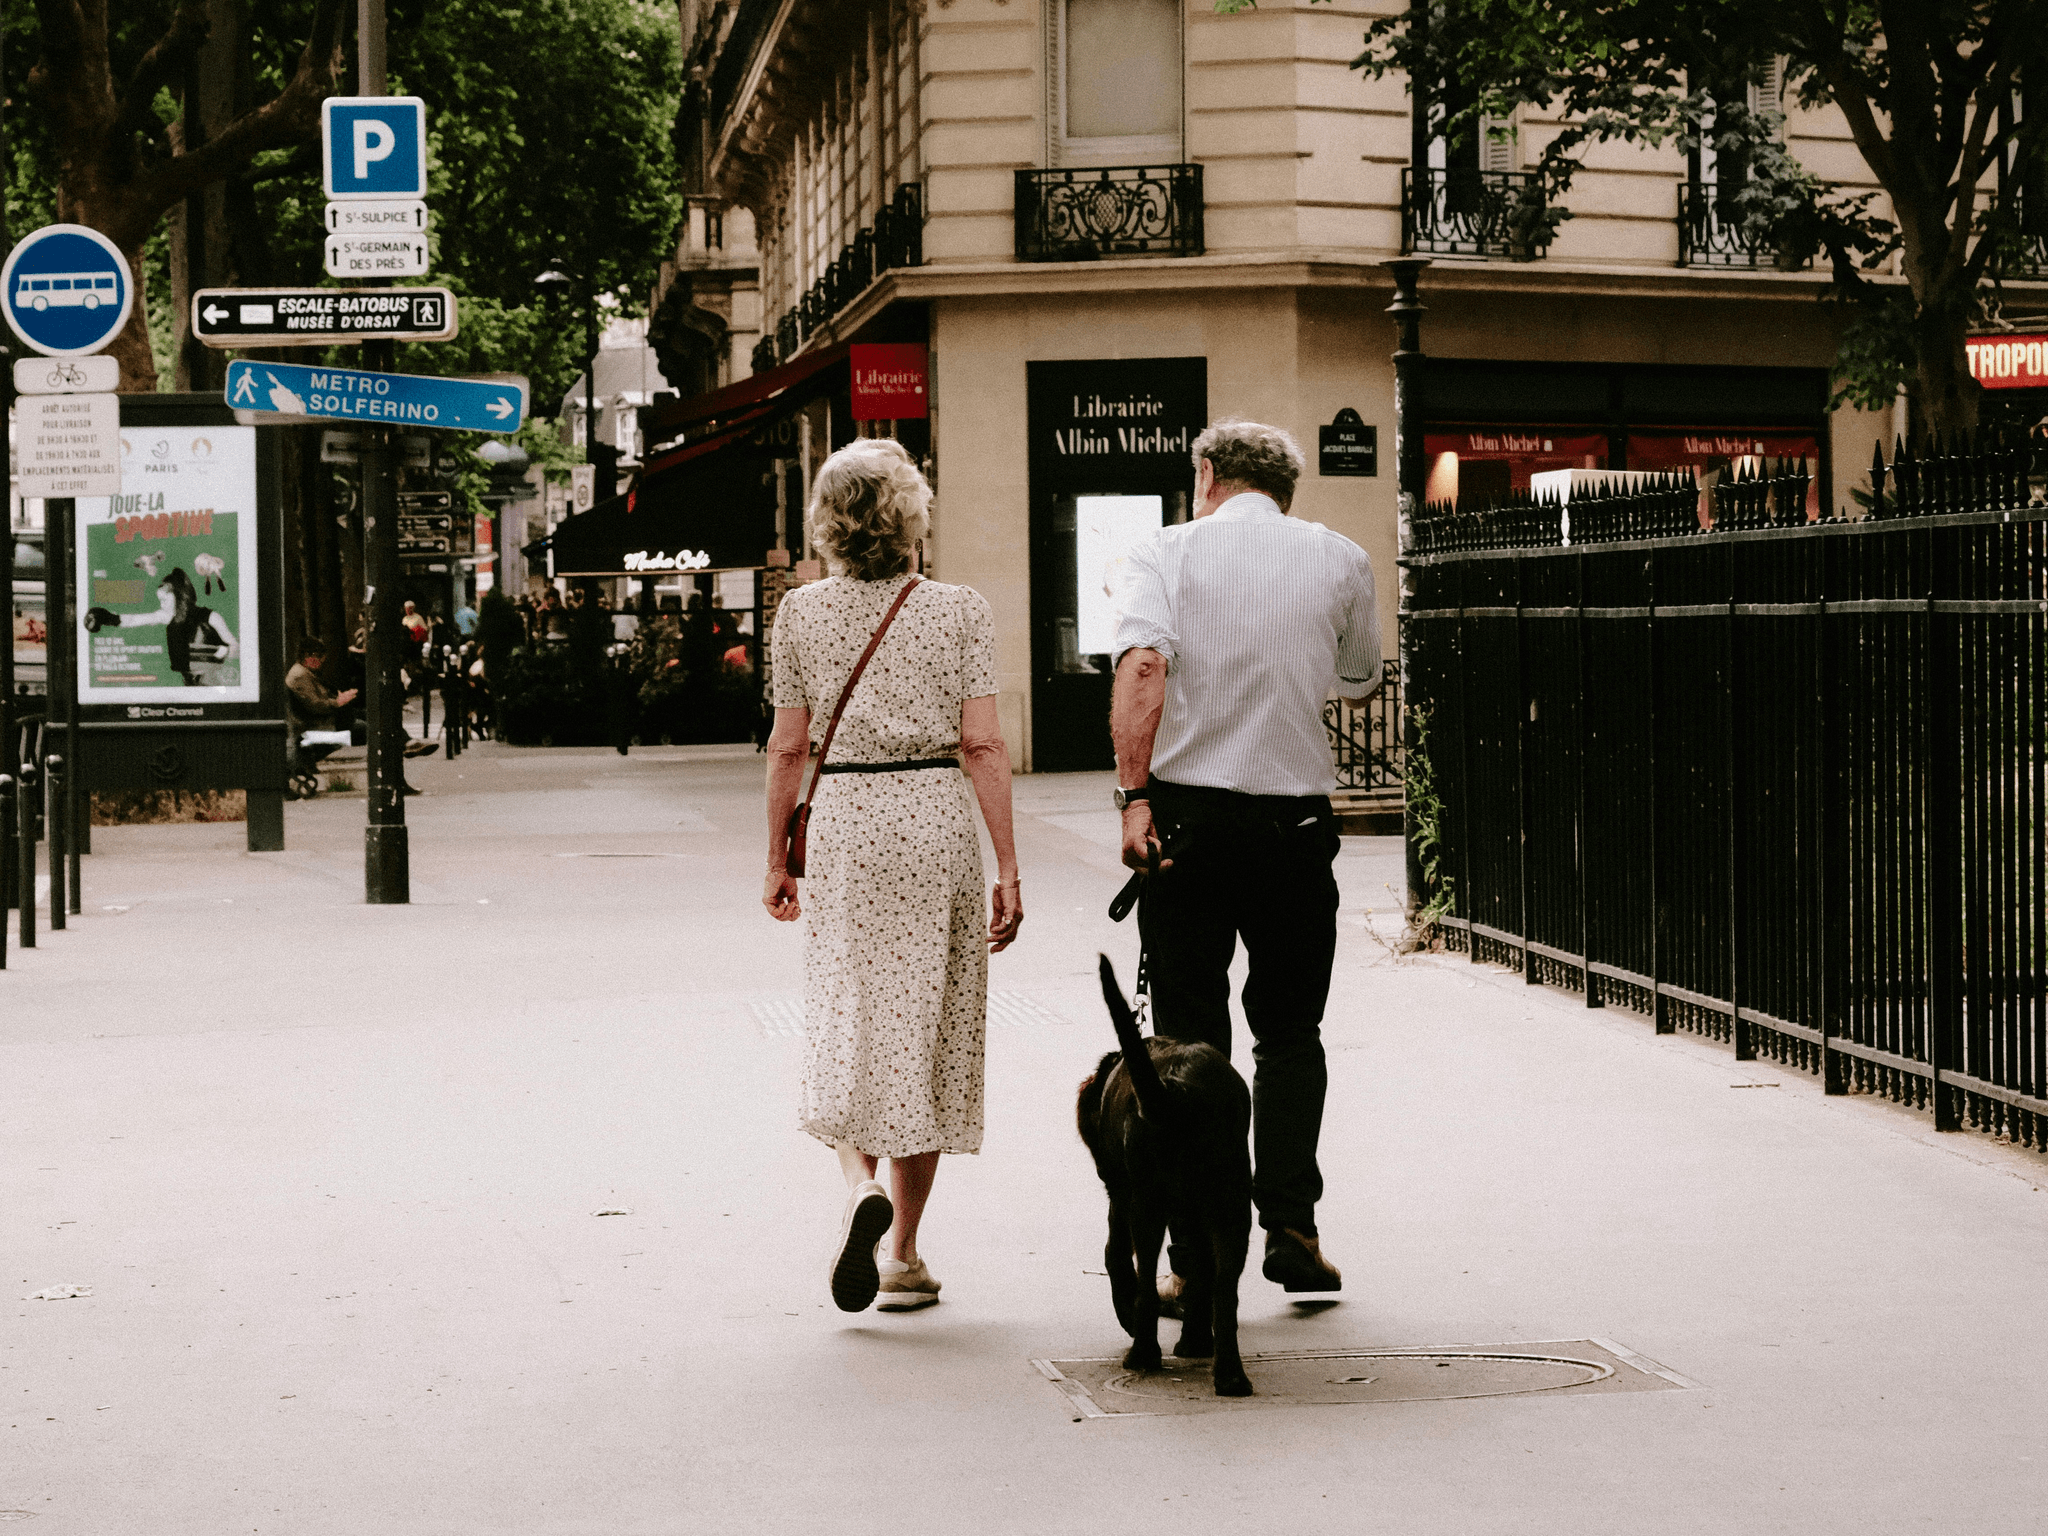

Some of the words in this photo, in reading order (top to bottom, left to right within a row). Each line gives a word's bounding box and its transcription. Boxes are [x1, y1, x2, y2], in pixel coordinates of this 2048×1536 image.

[353, 119, 396, 179] P
[350, 260, 371, 270] DES
[278, 297, 410, 314] ESCALE-BATOBUS
[287, 313, 334, 329] MUSÉE
[341, 314, 400, 328] D'ORSAY
[310, 373, 390, 395] METRO
[856, 369, 923, 385] Librairie
[42, 403, 60, 413] ARRÊT
[61, 403, 91, 413] AUTORISÉ
[309, 394, 439, 421] SOLFERINO
[1073, 394, 1163, 417] Librairie
[43, 420, 59, 429] POUR
[60, 419, 92, 429] LIVRAISON
[37, 435, 45, 445] DE
[90, 434, 98, 443] ET
[1055, 428, 1110, 455] Albin
[1117, 426, 1188, 453] Michel
[1469, 433, 1499, 451] Albin
[1502, 433, 1540, 451] Michel
[1684, 436, 1713, 453] Albin
[1715, 436, 1751, 454] Michel
[36, 451, 44, 460] DE
[88, 449, 101, 458] AUX
[22, 466, 71, 476] EMPLACEMENTS
[145, 464, 178, 473] PARIS
[57, 481, 68, 491] CET
[69, 480, 88, 490] EFFET
[108, 492, 164, 519] JOUE-LA
[114, 509, 214, 543] SPORTIVE
[141, 707, 165, 716] Clear
[166, 707, 204, 716] Channel
